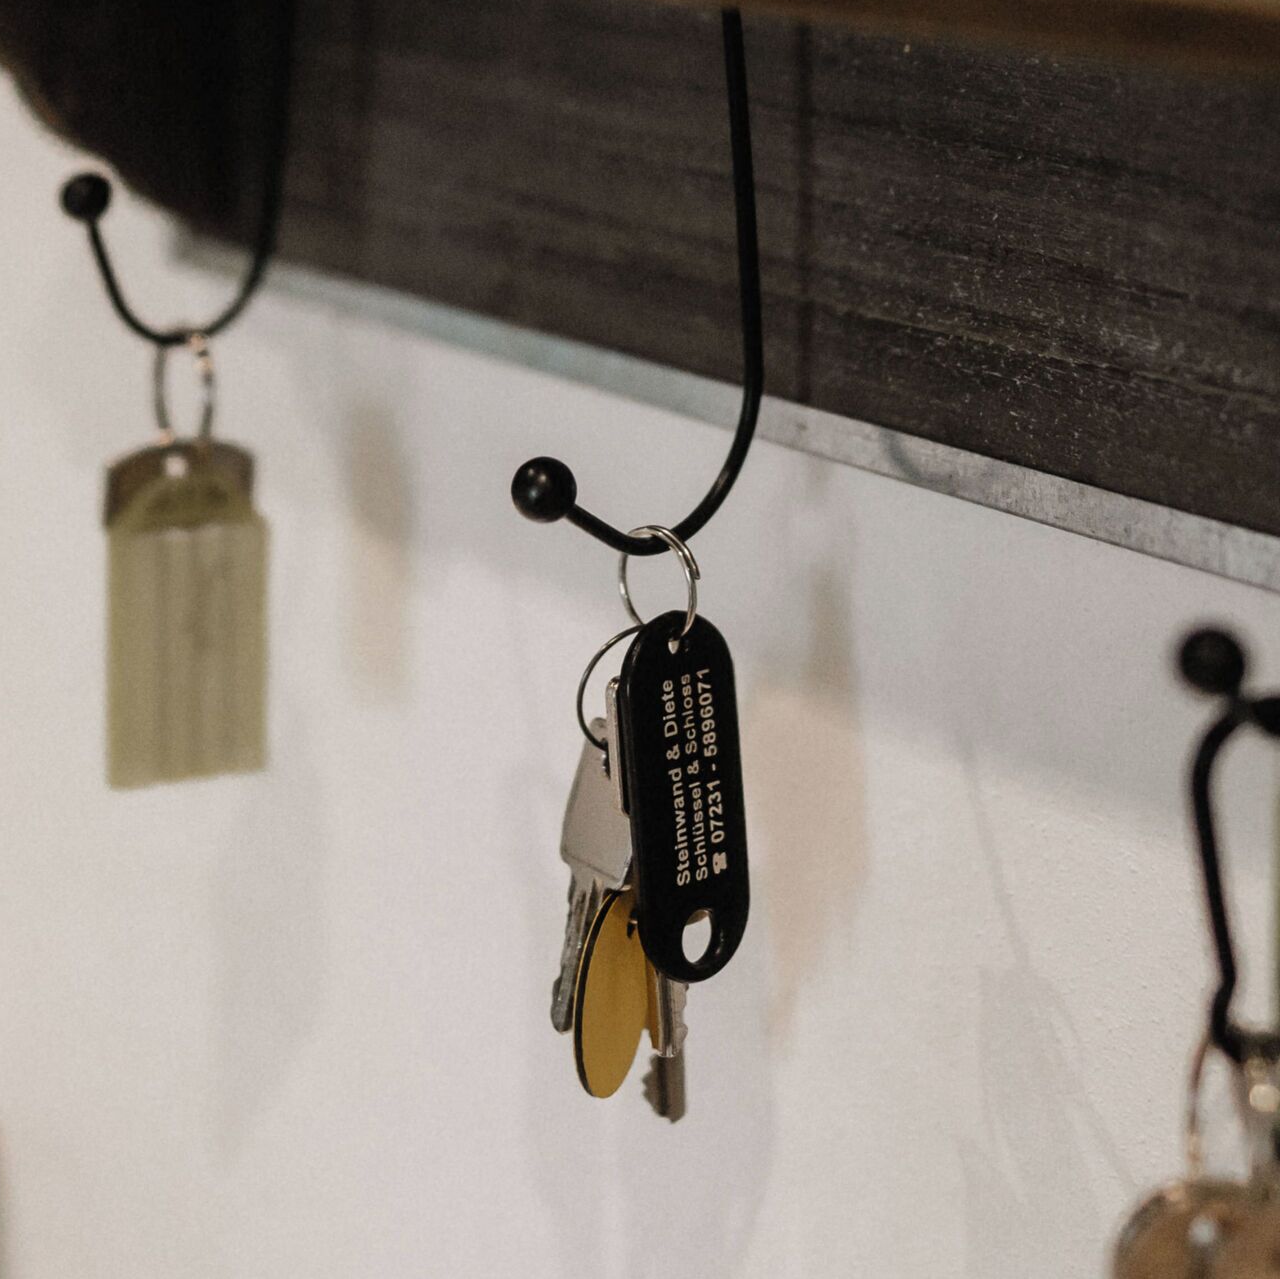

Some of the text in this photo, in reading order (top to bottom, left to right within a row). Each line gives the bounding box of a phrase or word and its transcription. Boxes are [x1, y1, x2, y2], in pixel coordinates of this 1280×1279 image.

[662, 679, 691, 886] Steinwand & Diete
[680, 674, 708, 881] Schlüssel & Schloss
[696, 668, 718, 757] 5896071
[706, 779, 725, 844] 07231
